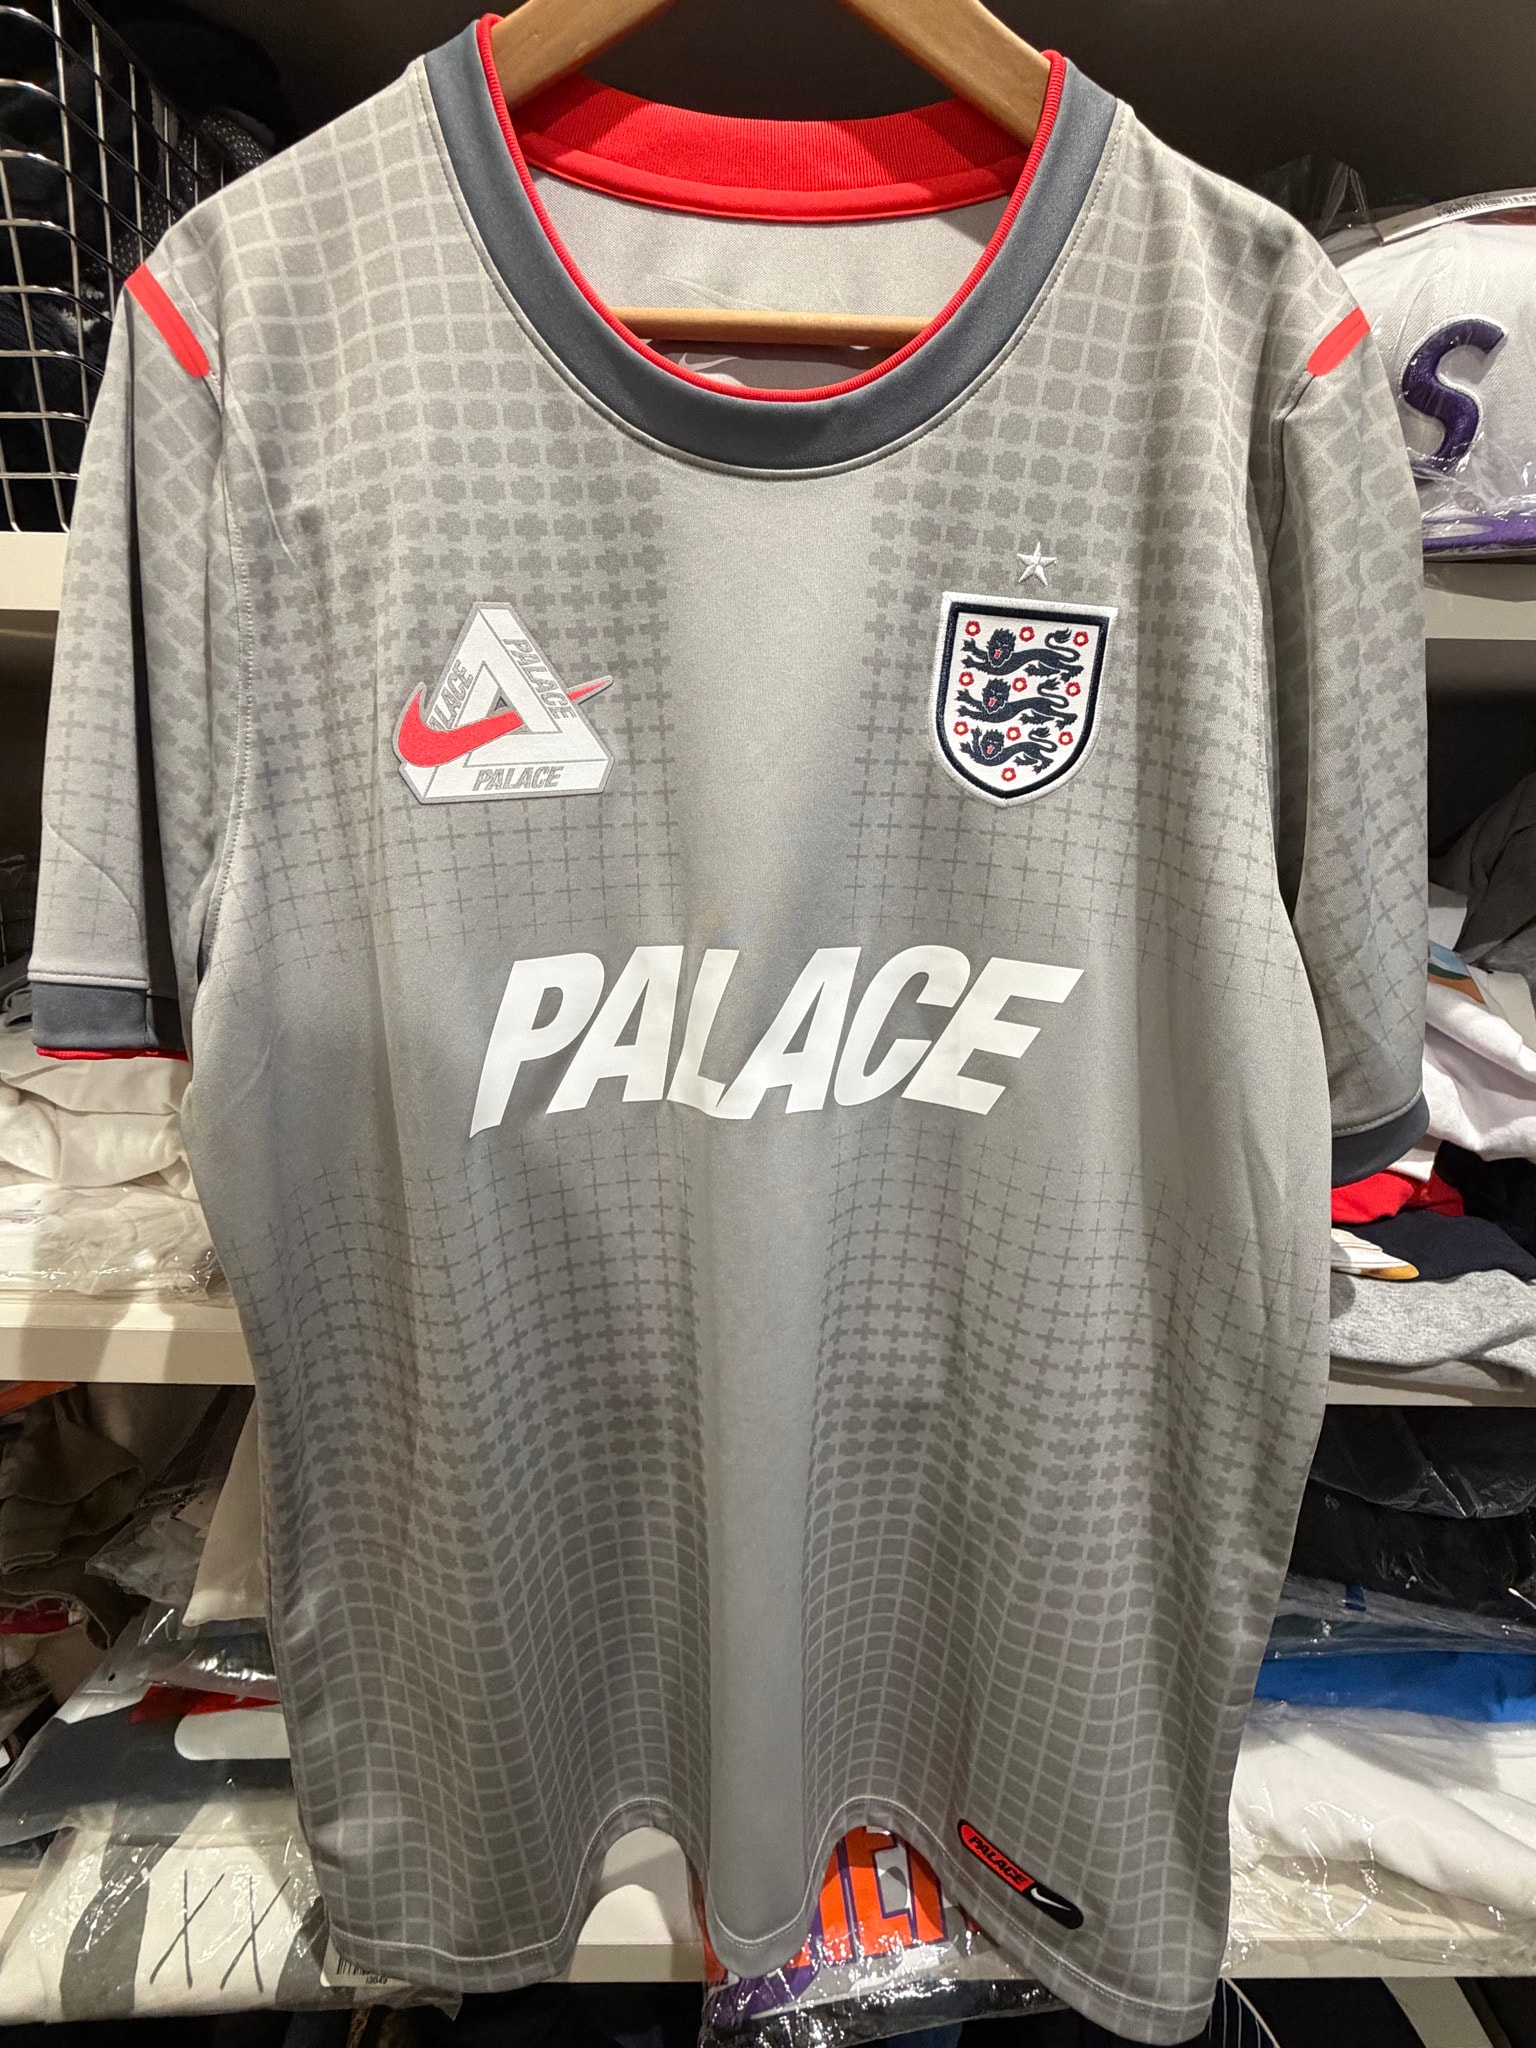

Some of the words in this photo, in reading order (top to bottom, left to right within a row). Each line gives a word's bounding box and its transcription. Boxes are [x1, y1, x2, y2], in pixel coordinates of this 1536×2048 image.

[428, 659, 474, 730] LACE
[500, 638, 577, 720] PALACE
[472, 766, 564, 791] PALACE
[470, 944, 1085, 1138] PALACE
[969, 1836, 1028, 1885] PALACE
